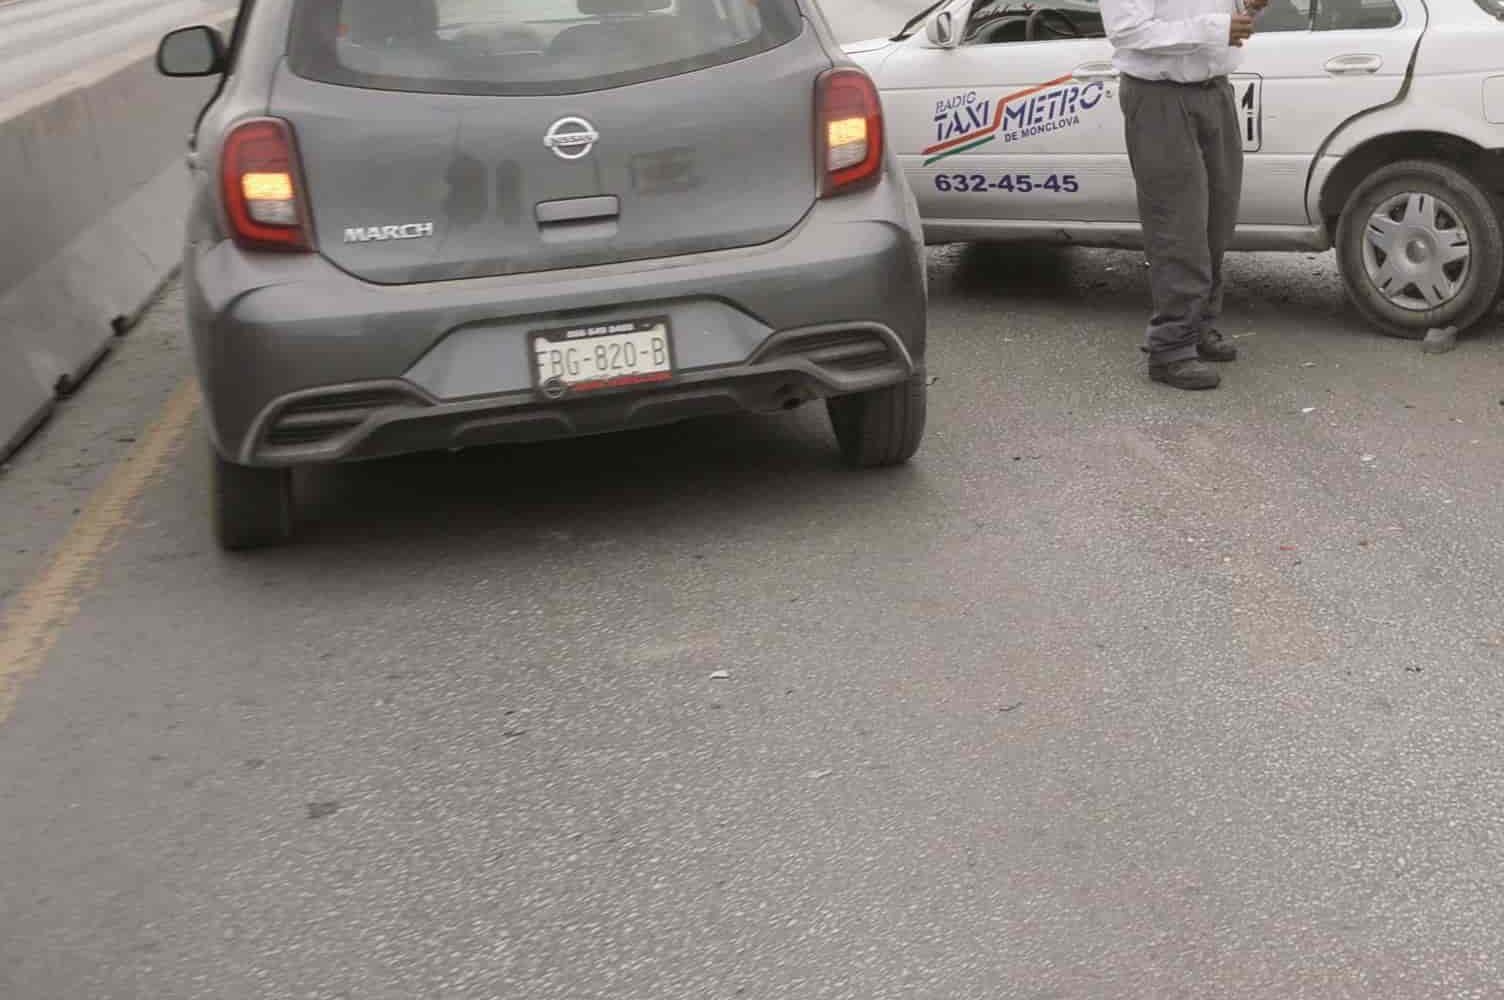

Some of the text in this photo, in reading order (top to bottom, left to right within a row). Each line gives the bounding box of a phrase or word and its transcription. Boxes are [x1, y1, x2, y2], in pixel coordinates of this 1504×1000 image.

[934, 80, 1104, 142] TAXI METRO
[1004, 115, 1080, 143] DE MONCLOVA
[935, 173, 1079, 193] 632-45-45
[344, 222, 433, 242] MARCH
